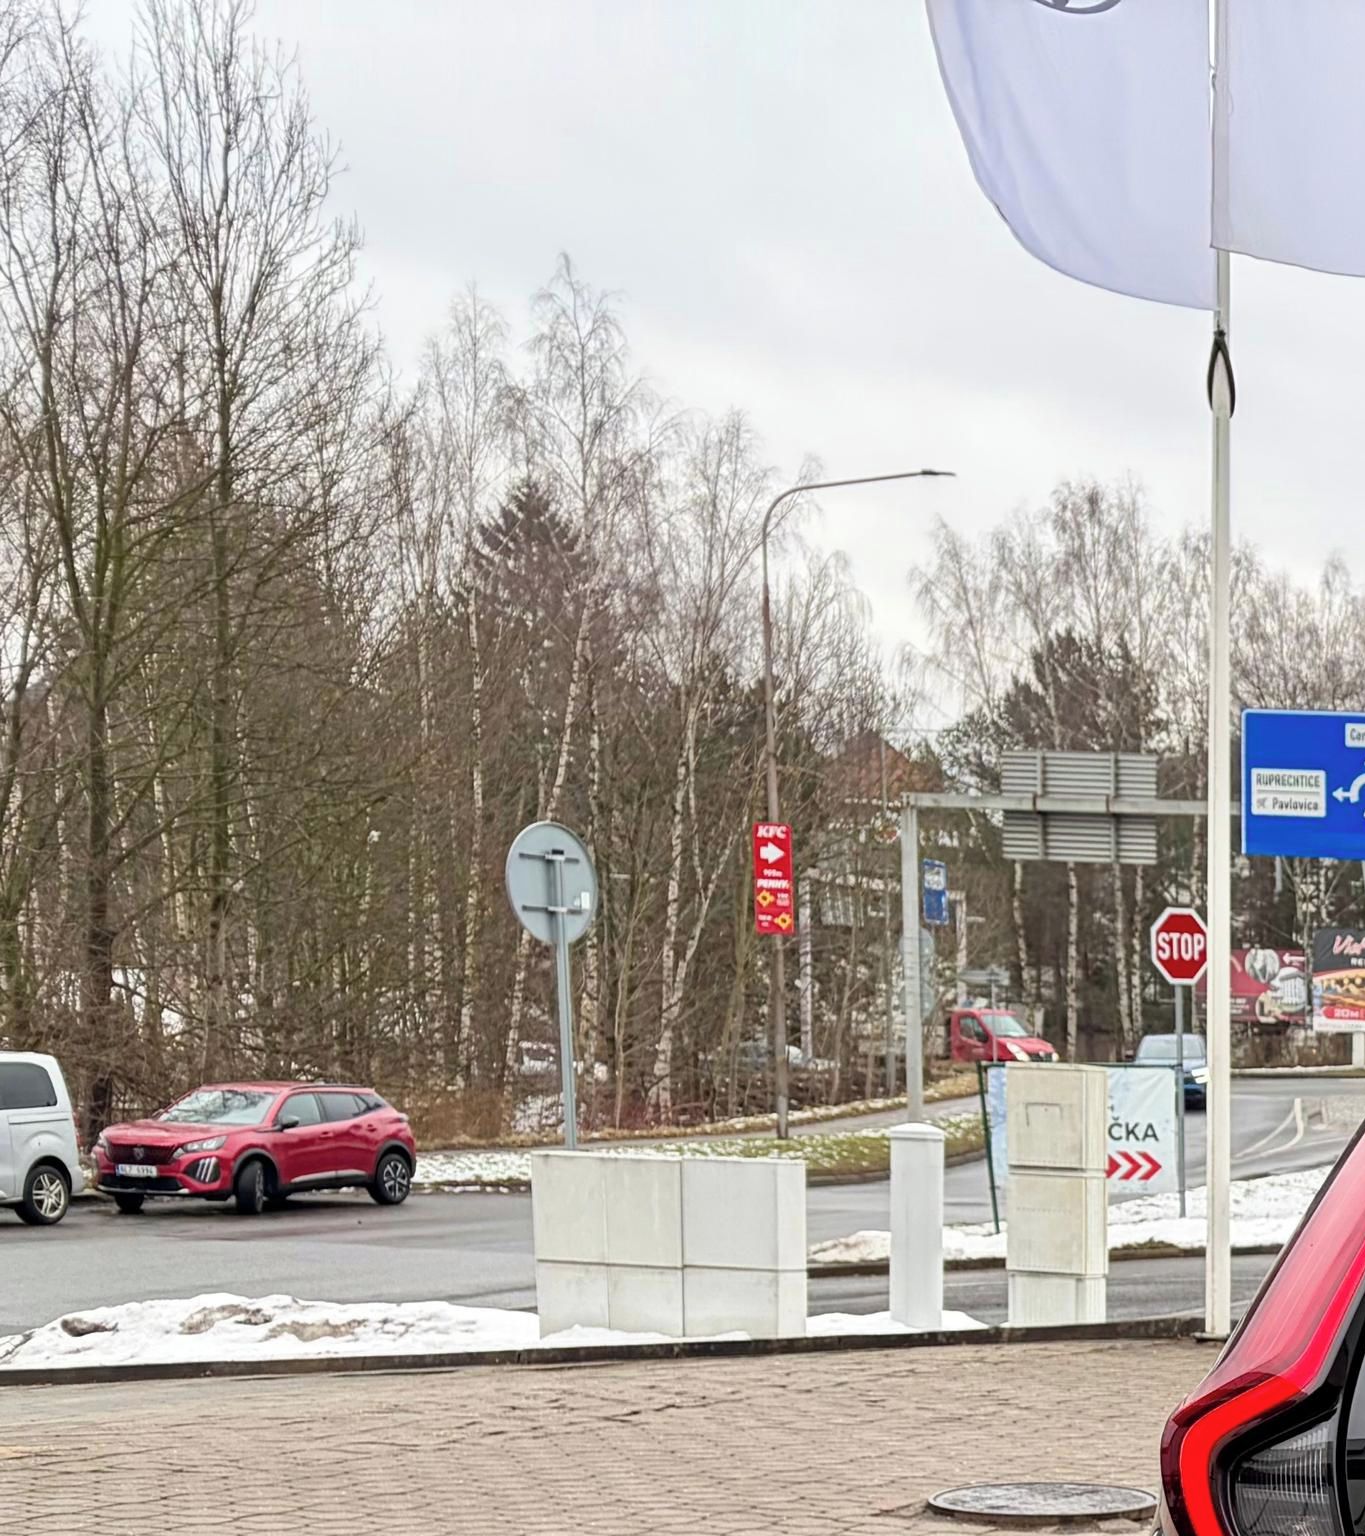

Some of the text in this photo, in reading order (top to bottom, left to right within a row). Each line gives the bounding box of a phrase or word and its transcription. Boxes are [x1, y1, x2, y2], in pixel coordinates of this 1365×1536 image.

[756, 825, 787, 840] KFC
[1158, 931, 1205, 961] STOP
[1108, 1116, 1160, 1142] ČKA
